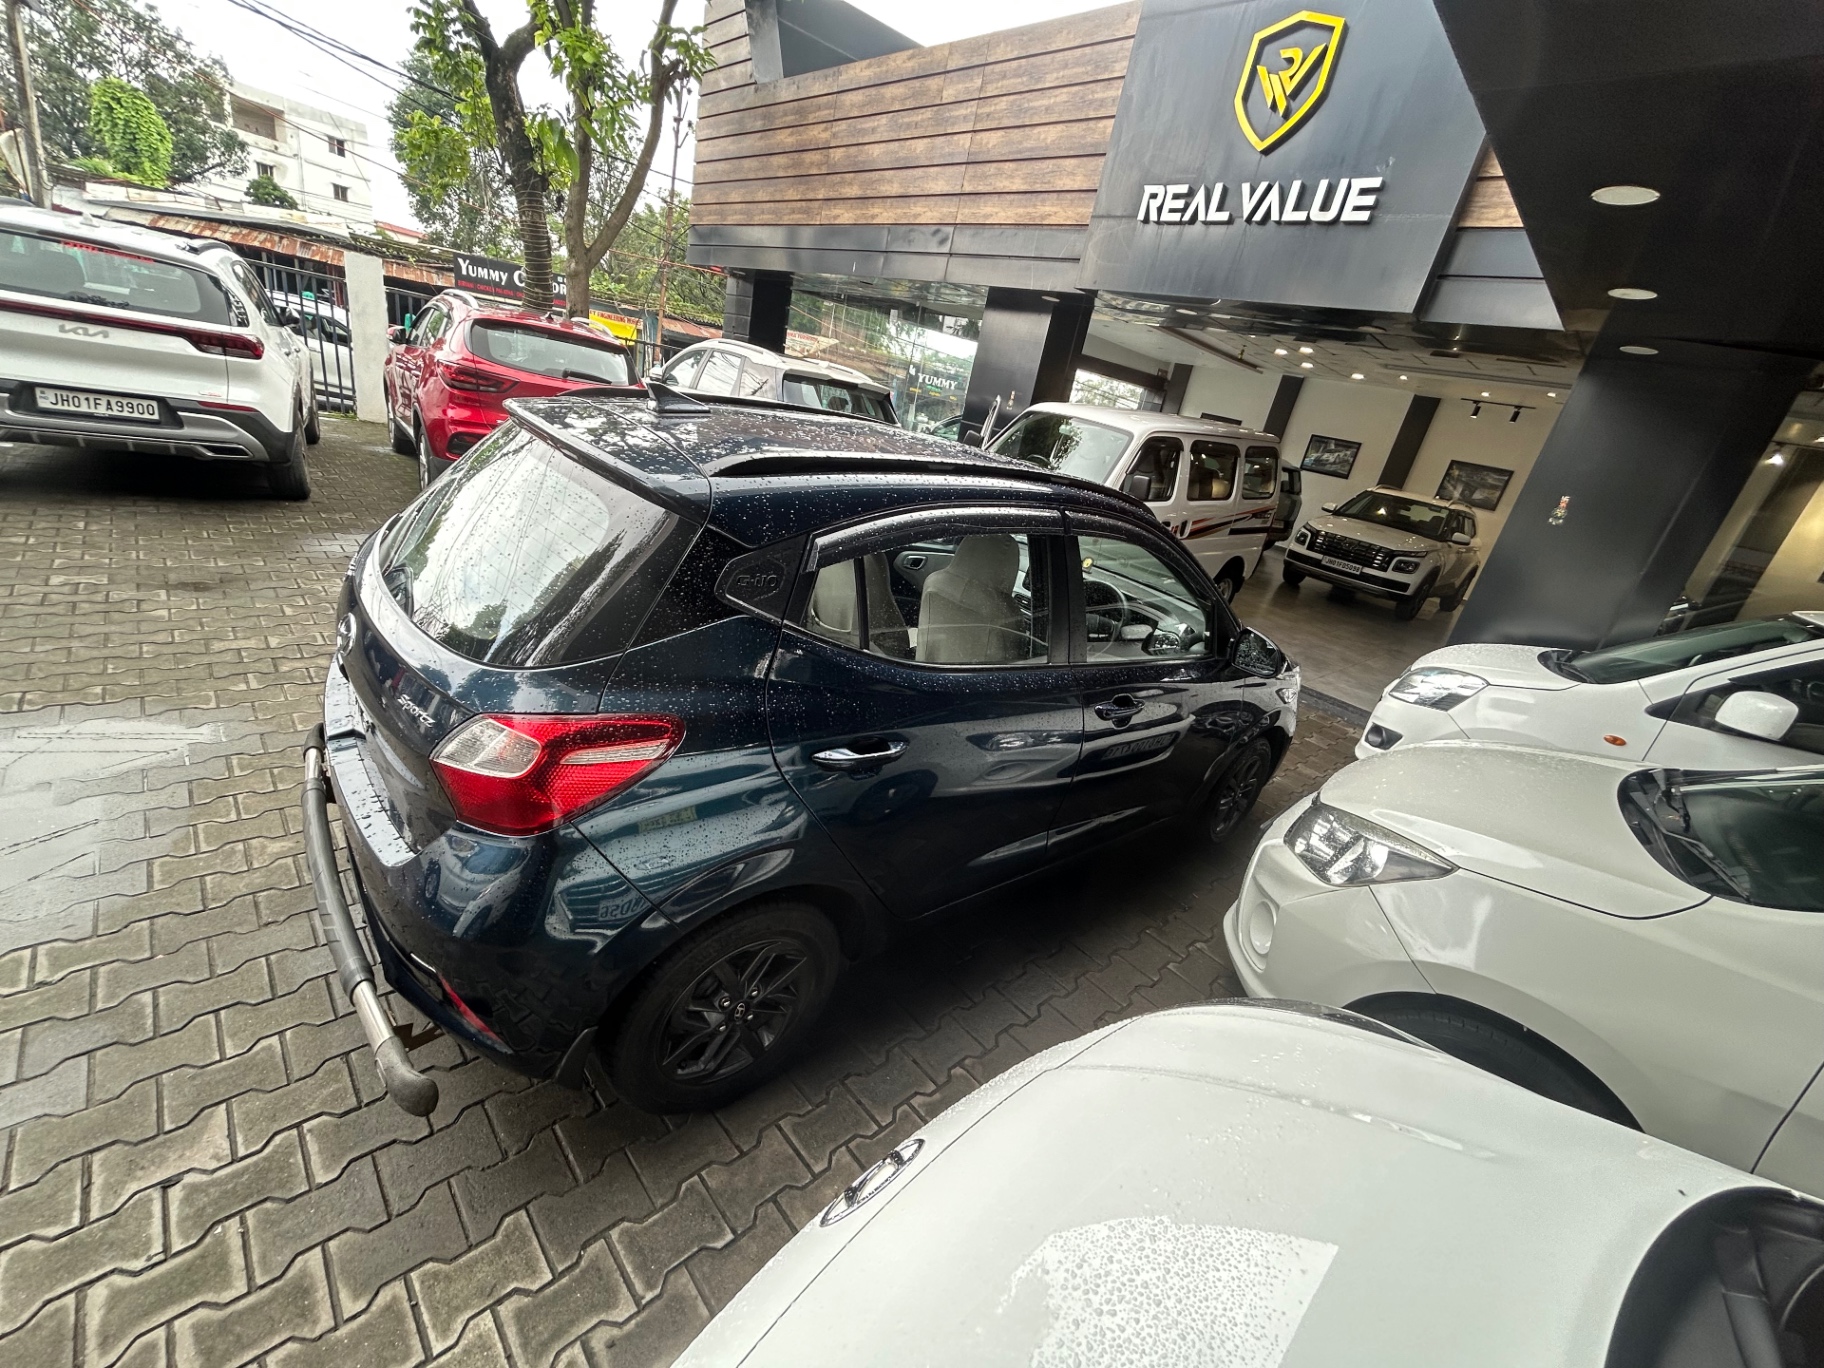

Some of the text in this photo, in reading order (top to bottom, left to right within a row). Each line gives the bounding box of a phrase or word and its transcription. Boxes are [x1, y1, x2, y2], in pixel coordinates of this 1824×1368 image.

[1137, 177, 1384, 223] REAL VALUE
[918, 372, 958, 390] YUMMY
[50, 392, 156, 416] JH01FA9900
